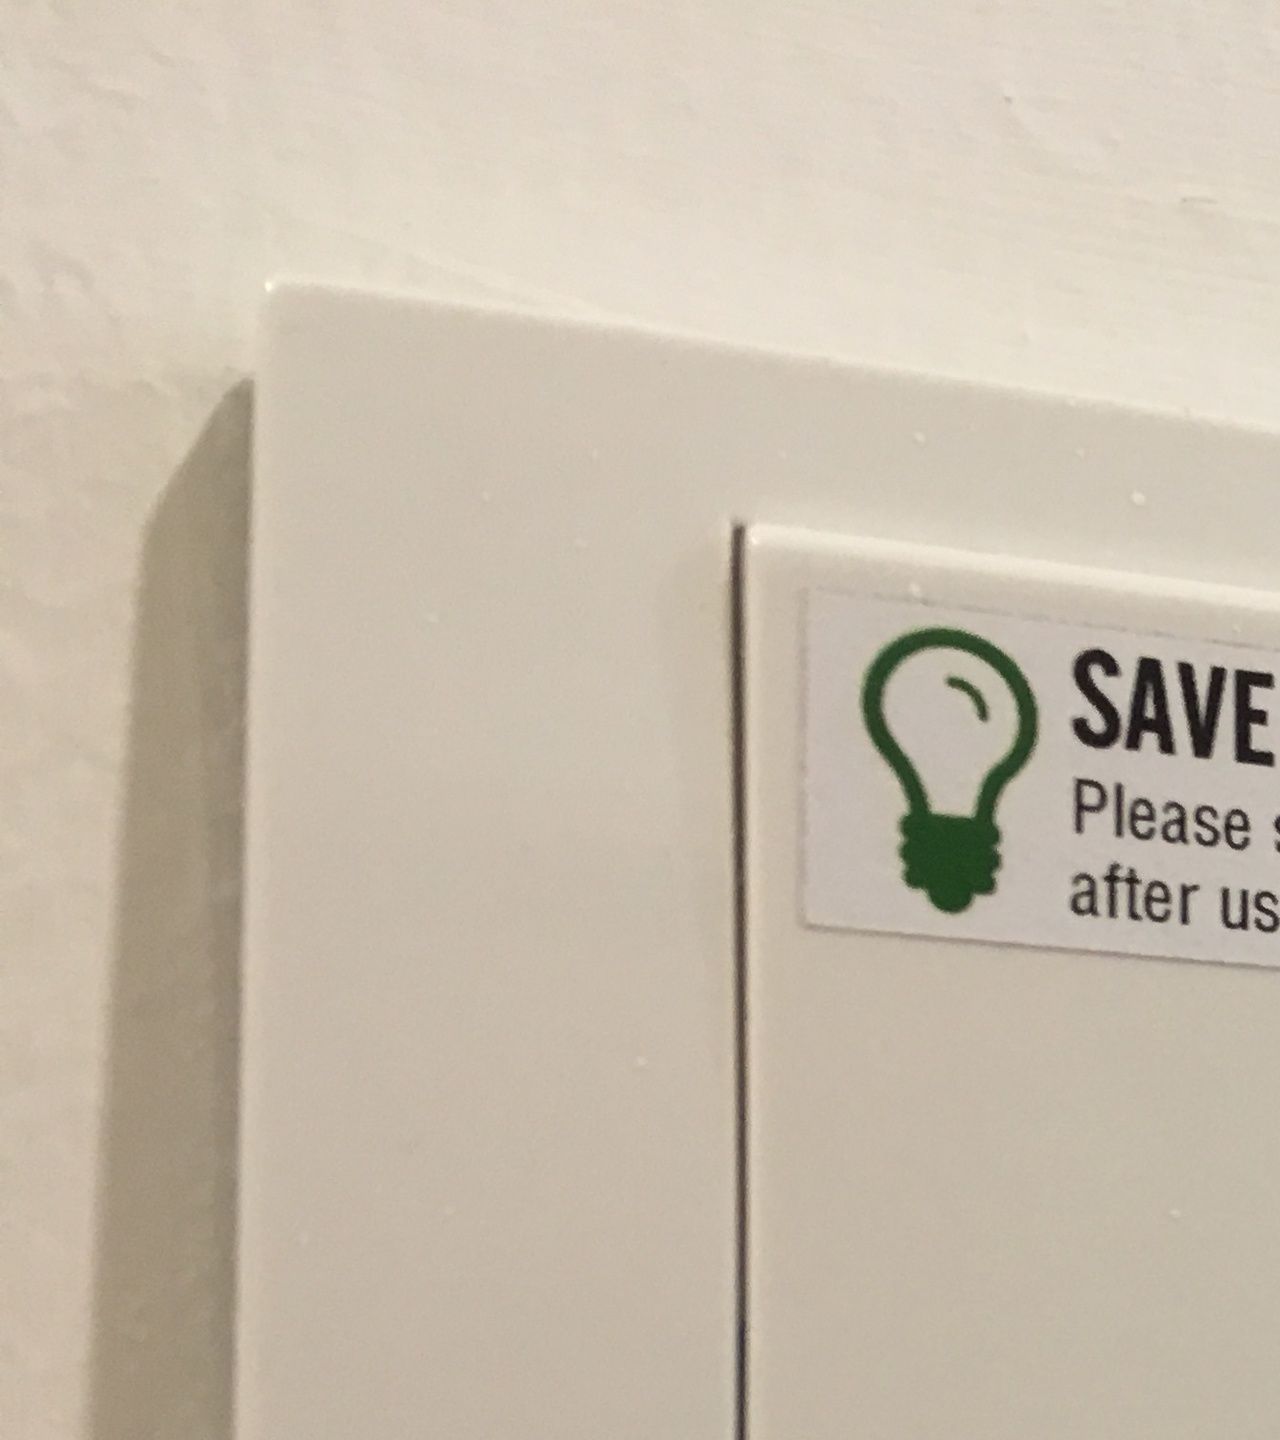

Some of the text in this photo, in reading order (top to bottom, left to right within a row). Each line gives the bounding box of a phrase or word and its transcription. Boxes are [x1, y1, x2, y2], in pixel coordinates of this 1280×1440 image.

[1071, 648, 1276, 768] SAVE
[1073, 778, 1252, 852] Please
[1069, 863, 1200, 927] after
